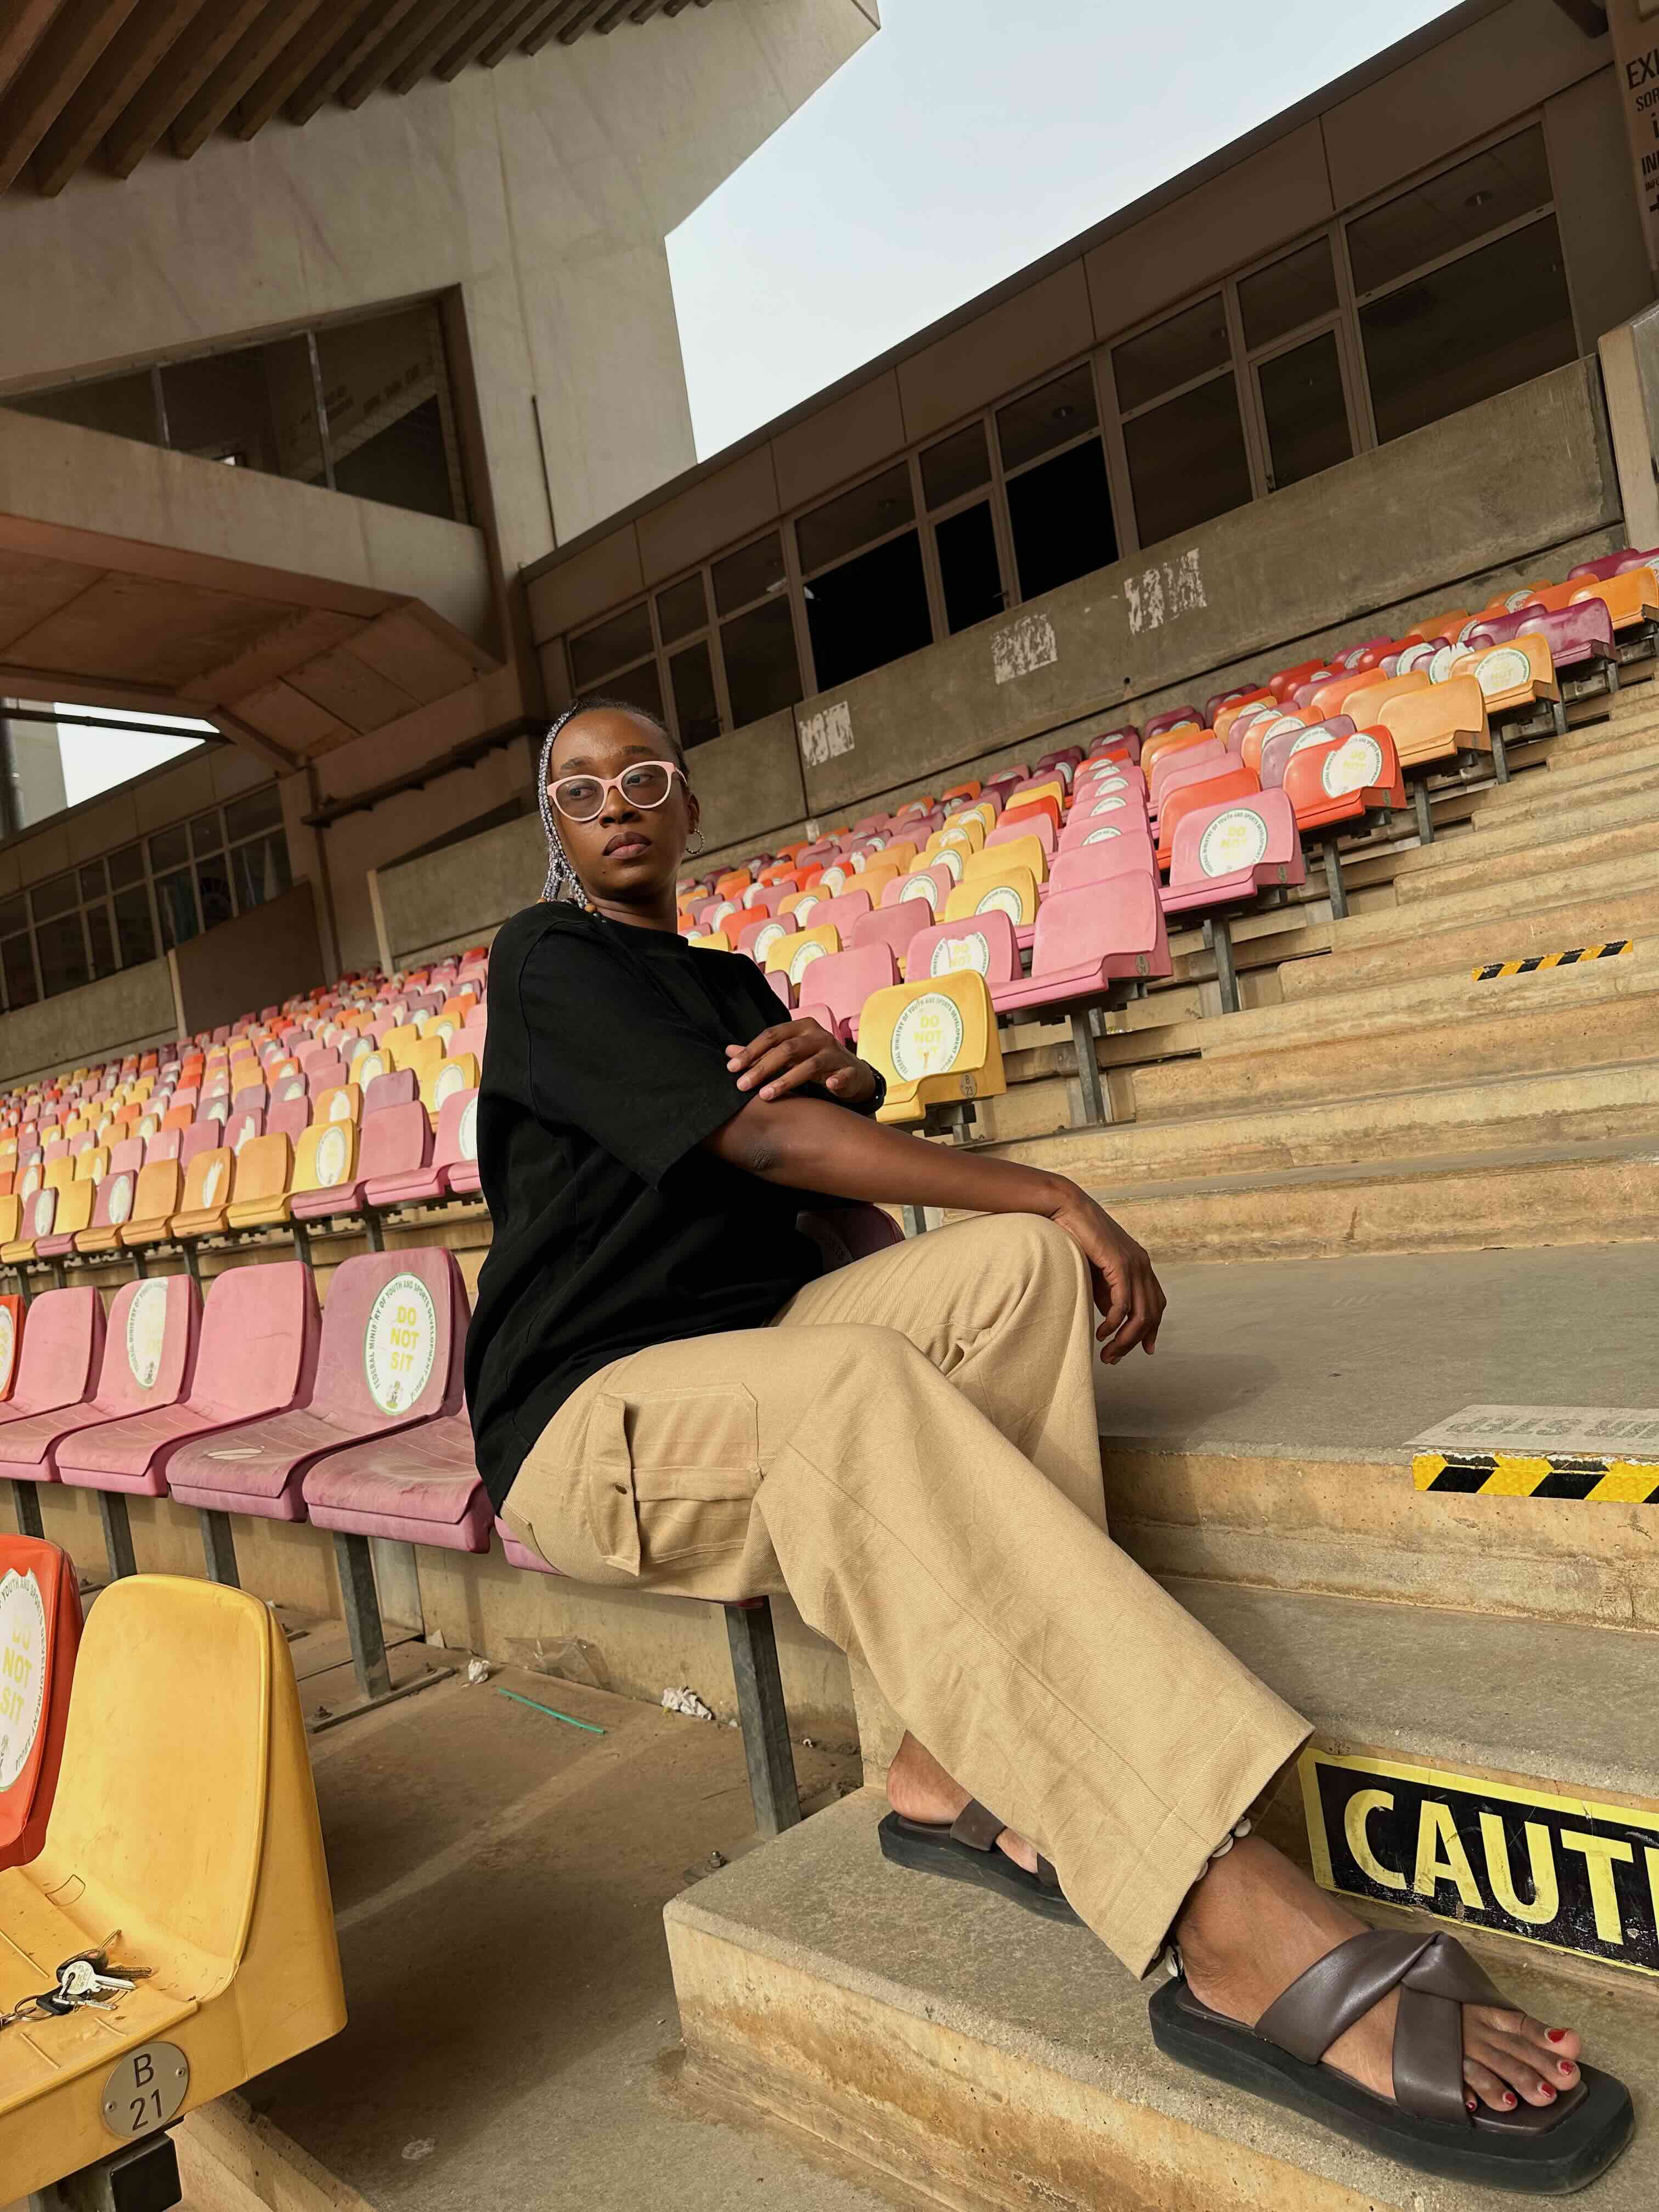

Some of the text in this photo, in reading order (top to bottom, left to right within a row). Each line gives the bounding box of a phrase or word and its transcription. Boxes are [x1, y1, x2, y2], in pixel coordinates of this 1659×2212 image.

[921, 1015, 940, 1029] DO
[965, 1074, 970, 1085] B
[385, 1282, 403, 1299] YOUTH
[396, 1306, 417, 1326] DO
[390, 1327, 421, 1351] NOT
[390, 1351, 415, 1372] SIT
[2, 1578, 19, 1598] YOUTH
[2, 1646, 33, 1689] NOT
[1344, 1788, 1659, 1946] CAUT
[133, 2053, 154, 2088] B
[129, 2089, 162, 2131] 21
